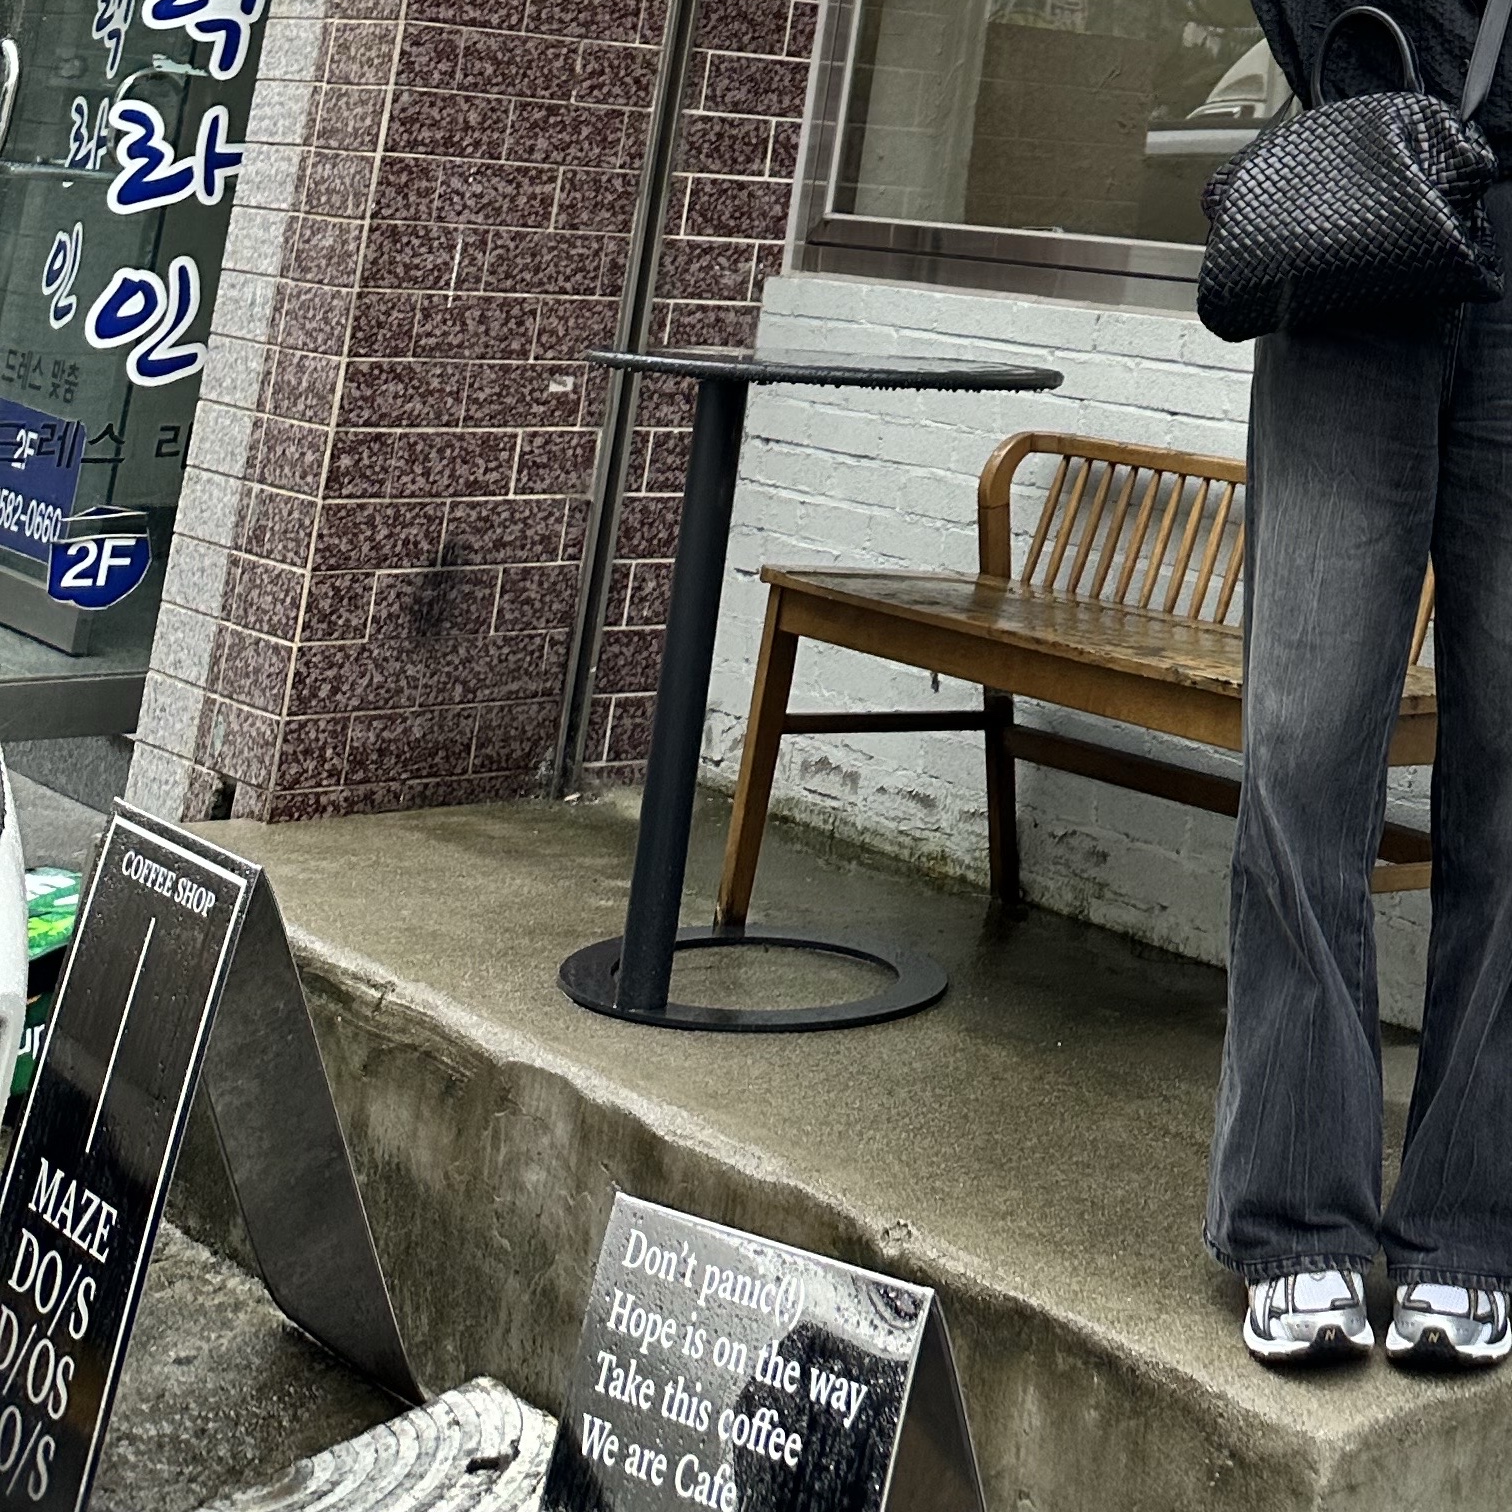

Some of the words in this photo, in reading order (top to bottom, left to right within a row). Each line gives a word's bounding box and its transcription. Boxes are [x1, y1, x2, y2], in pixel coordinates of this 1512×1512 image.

[60, 538, 138, 589] 2F
[121, 849, 178, 899] COFFEE
[173, 875, 217, 919] SHOP
[28, 1157, 118, 1264] MAZE
[8, 1228, 97, 1340] DO/S
[621, 1228, 697, 1288] Don't
[696, 1261, 806, 1329] panic(!)
[594, 1351, 656, 1413] Take
[661, 1375, 710, 1433] this
[717, 1406, 803, 1467] coffee
[606, 1287, 678, 1355] Hope
[683, 1311, 705, 1359] is
[713, 1336, 748, 1373] on
[757, 1339, 801, 1392] the
[809, 1366, 869, 1429] way
[581, 1412, 617, 1466] We
[625, 1442, 668, 1486] are
